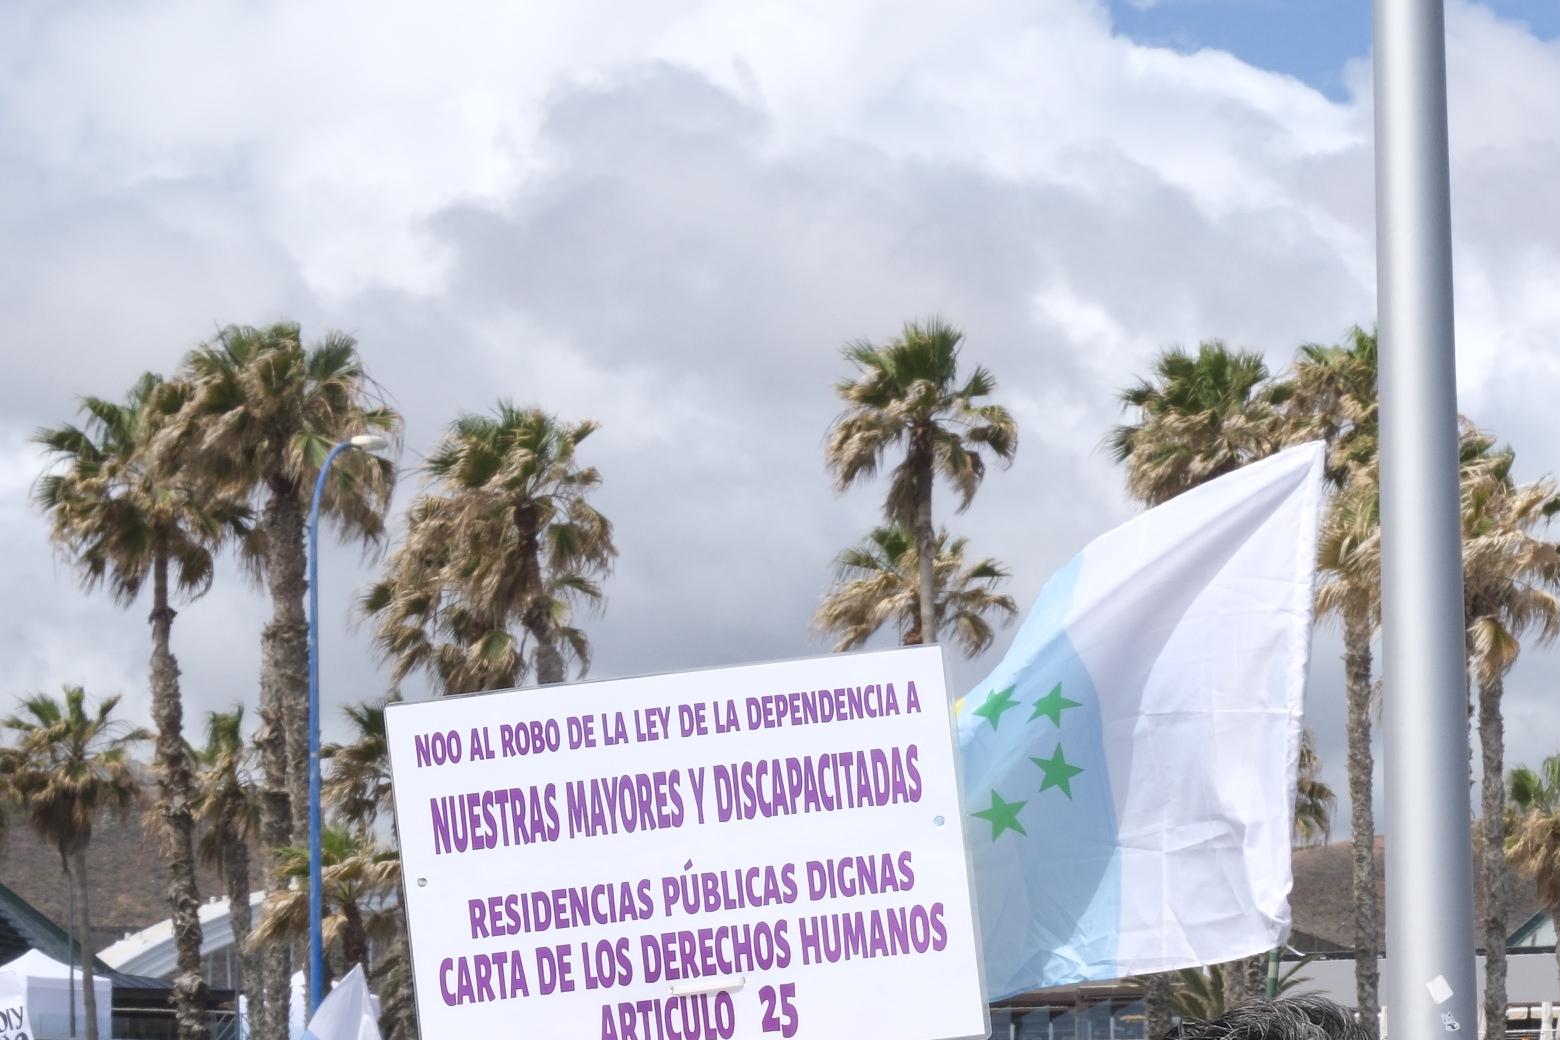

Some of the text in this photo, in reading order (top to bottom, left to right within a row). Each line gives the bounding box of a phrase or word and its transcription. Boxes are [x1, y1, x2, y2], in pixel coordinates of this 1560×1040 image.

[415, 681, 921, 767] NOO AL ROBO DE LA LEY DE LA DEPENDENCIA A
[431, 744, 922, 854] NUESTRAS MAYORES Y DISCAPACITADAS
[468, 850, 914, 938] RESIDENCIAS PÚBLICAS DIGNAS
[439, 902, 947, 1006] CARTA DE LOS DERECHOS HUMANOS
[758, 982, 799, 1038] 25
